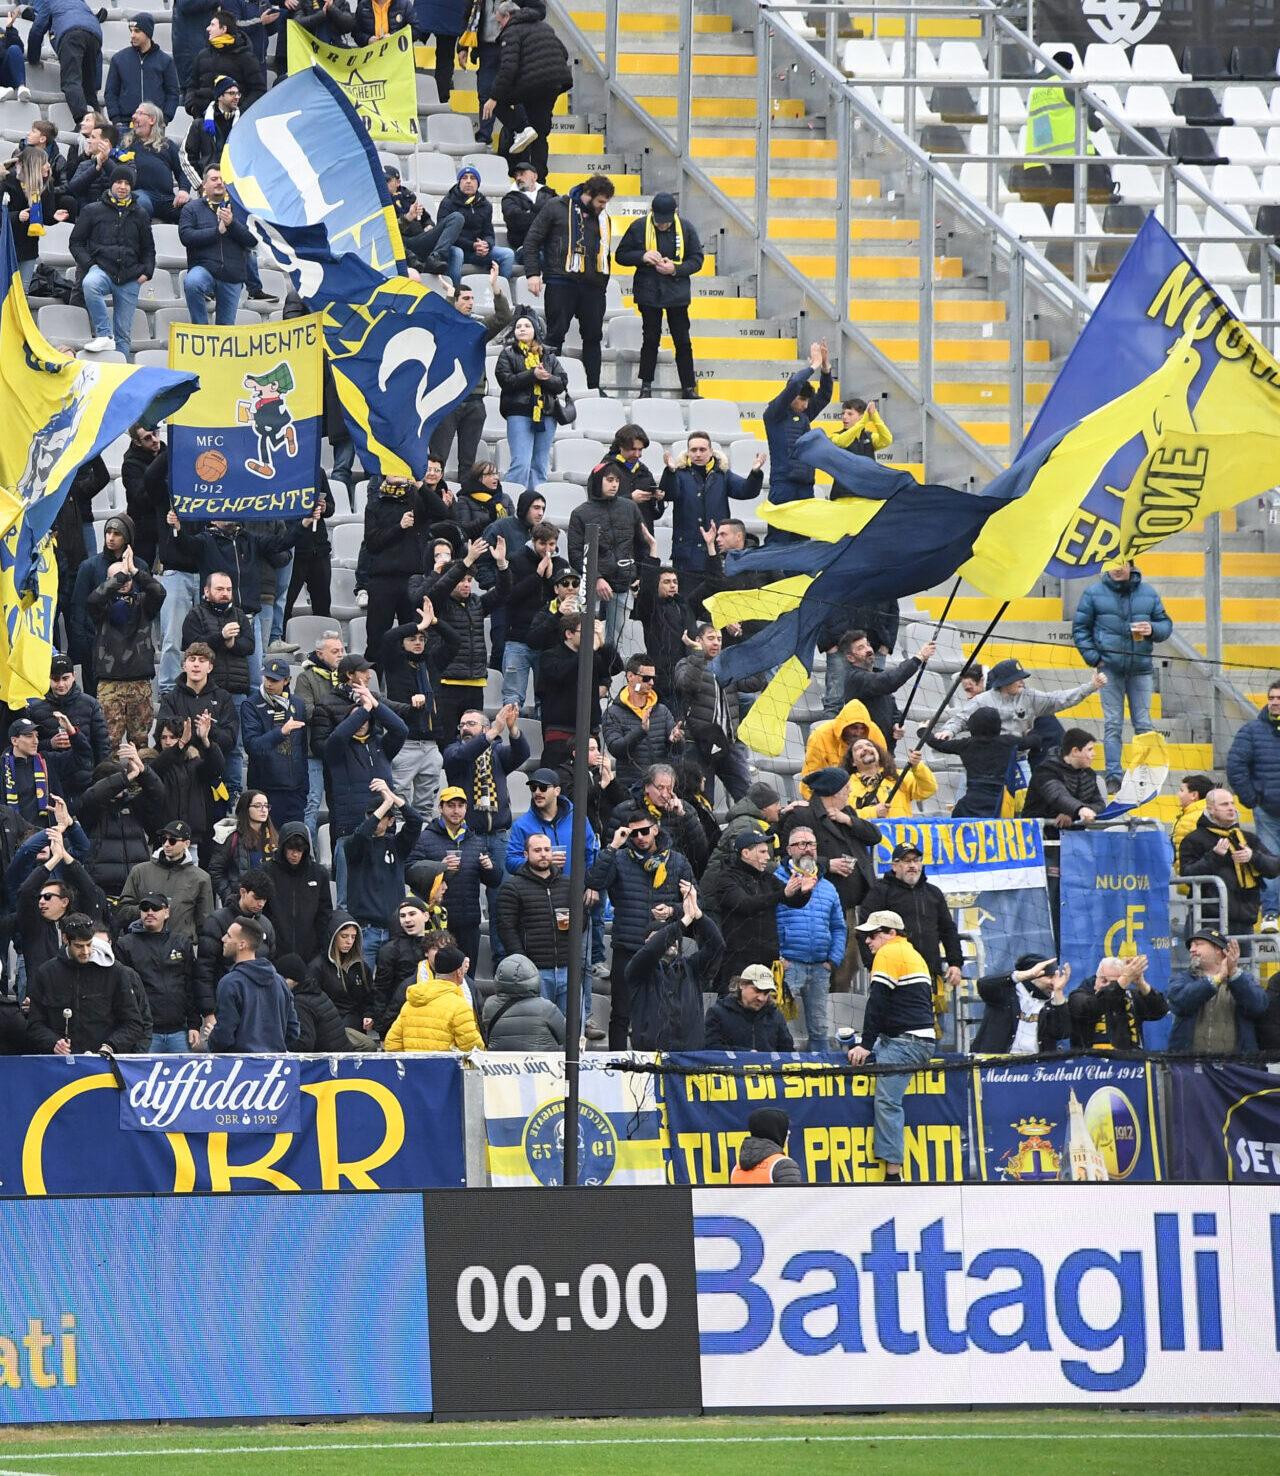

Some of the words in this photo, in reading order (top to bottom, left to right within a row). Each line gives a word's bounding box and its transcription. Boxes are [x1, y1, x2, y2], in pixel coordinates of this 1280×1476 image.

[708, 289, 725, 297] ROW
[176, 323, 317, 358] TOTALMENTE
[749, 329, 766, 337] ROW
[705, 370, 715, 378] 17
[196, 435, 224, 447] MFC
[194, 484, 223, 494] 1912
[877, 818, 1037, 866] SPINGERE
[1096, 874, 1151, 891] NUOVA
[1259, 944, 1276, 953] FILA
[744, 1064, 777, 1100] DI
[784, 1062, 844, 1098] SAN
[982, 1067, 1029, 1083] Modena
[1032, 1066, 1083, 1082] Football
[1085, 1064, 1114, 1081] Club
[1117, 1066, 1145, 1080] 1912
[130, 1060, 291, 1127] diffidati
[215, 1114, 239, 1125] QBR
[253, 1114, 278, 1125] 1912
[1115, 1126, 1136, 1140] 1912
[804, 1125, 963, 1183] PRESNTI
[456, 1263, 668, 1332] 00:00
[696, 1212, 1224, 1392] Battagli
